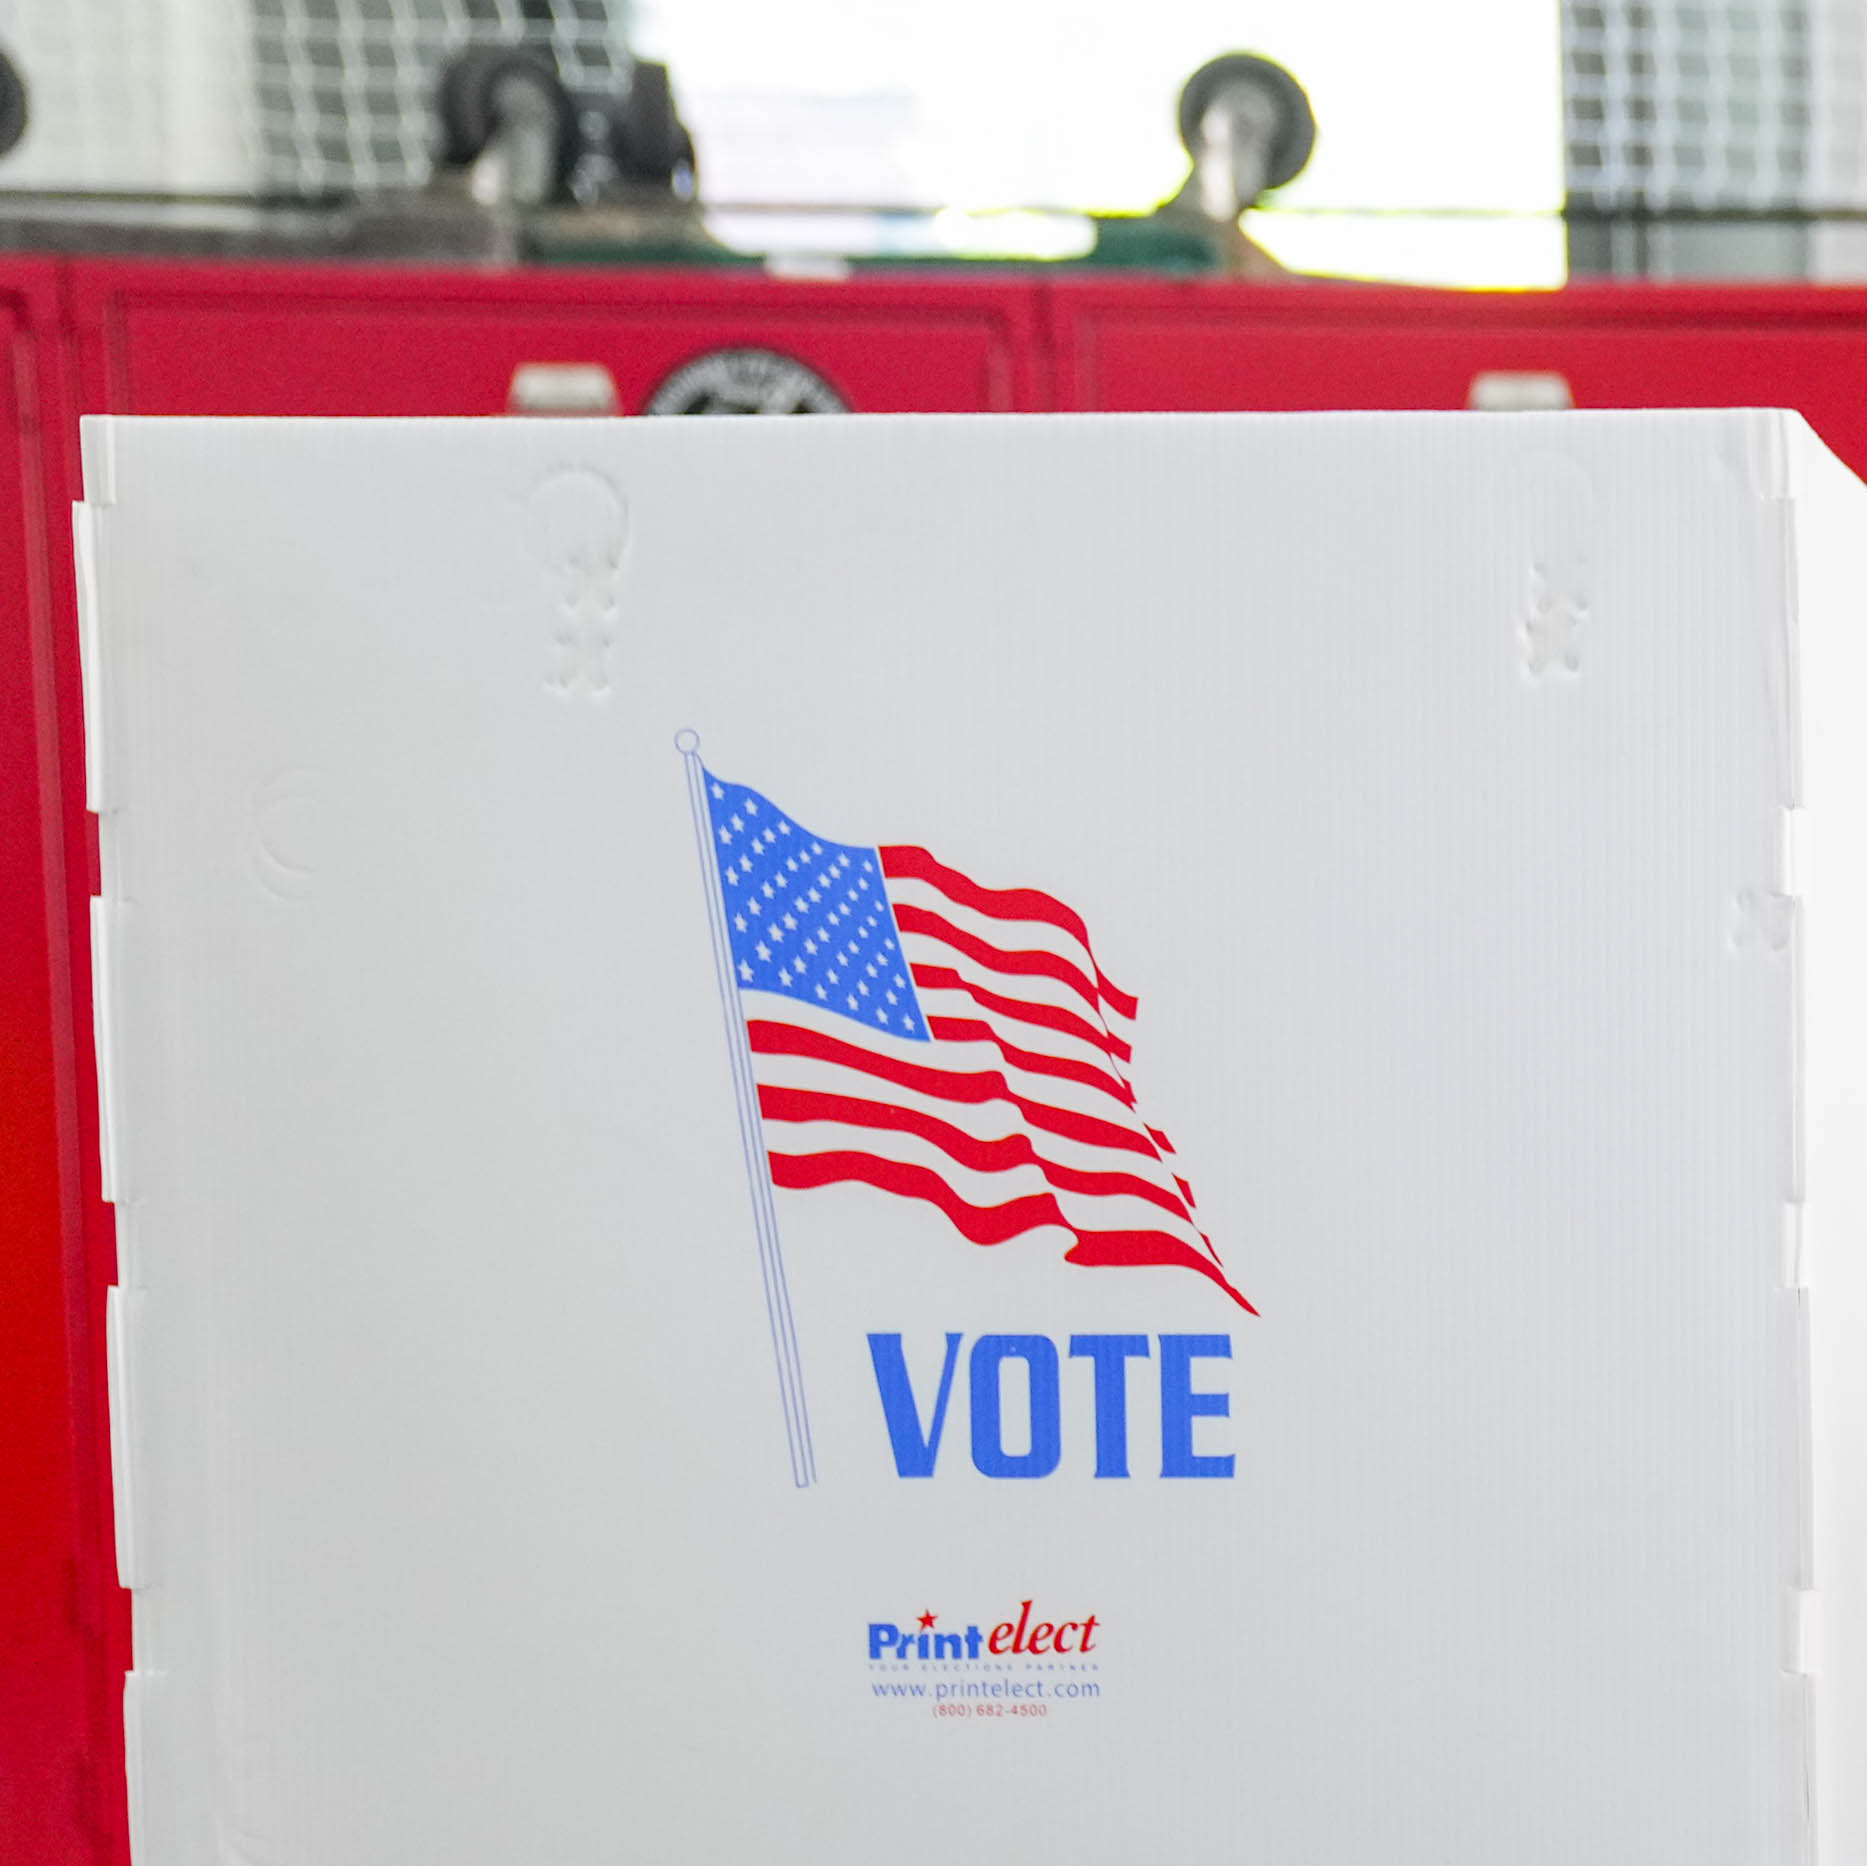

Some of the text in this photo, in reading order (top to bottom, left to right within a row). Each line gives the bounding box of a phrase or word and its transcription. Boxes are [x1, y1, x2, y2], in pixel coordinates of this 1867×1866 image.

[866, 1332, 1236, 1479] VOTE
[871, 1679, 1101, 1701] www.printelect.com
[932, 1703, 1048, 1718] (800) 682-4500
